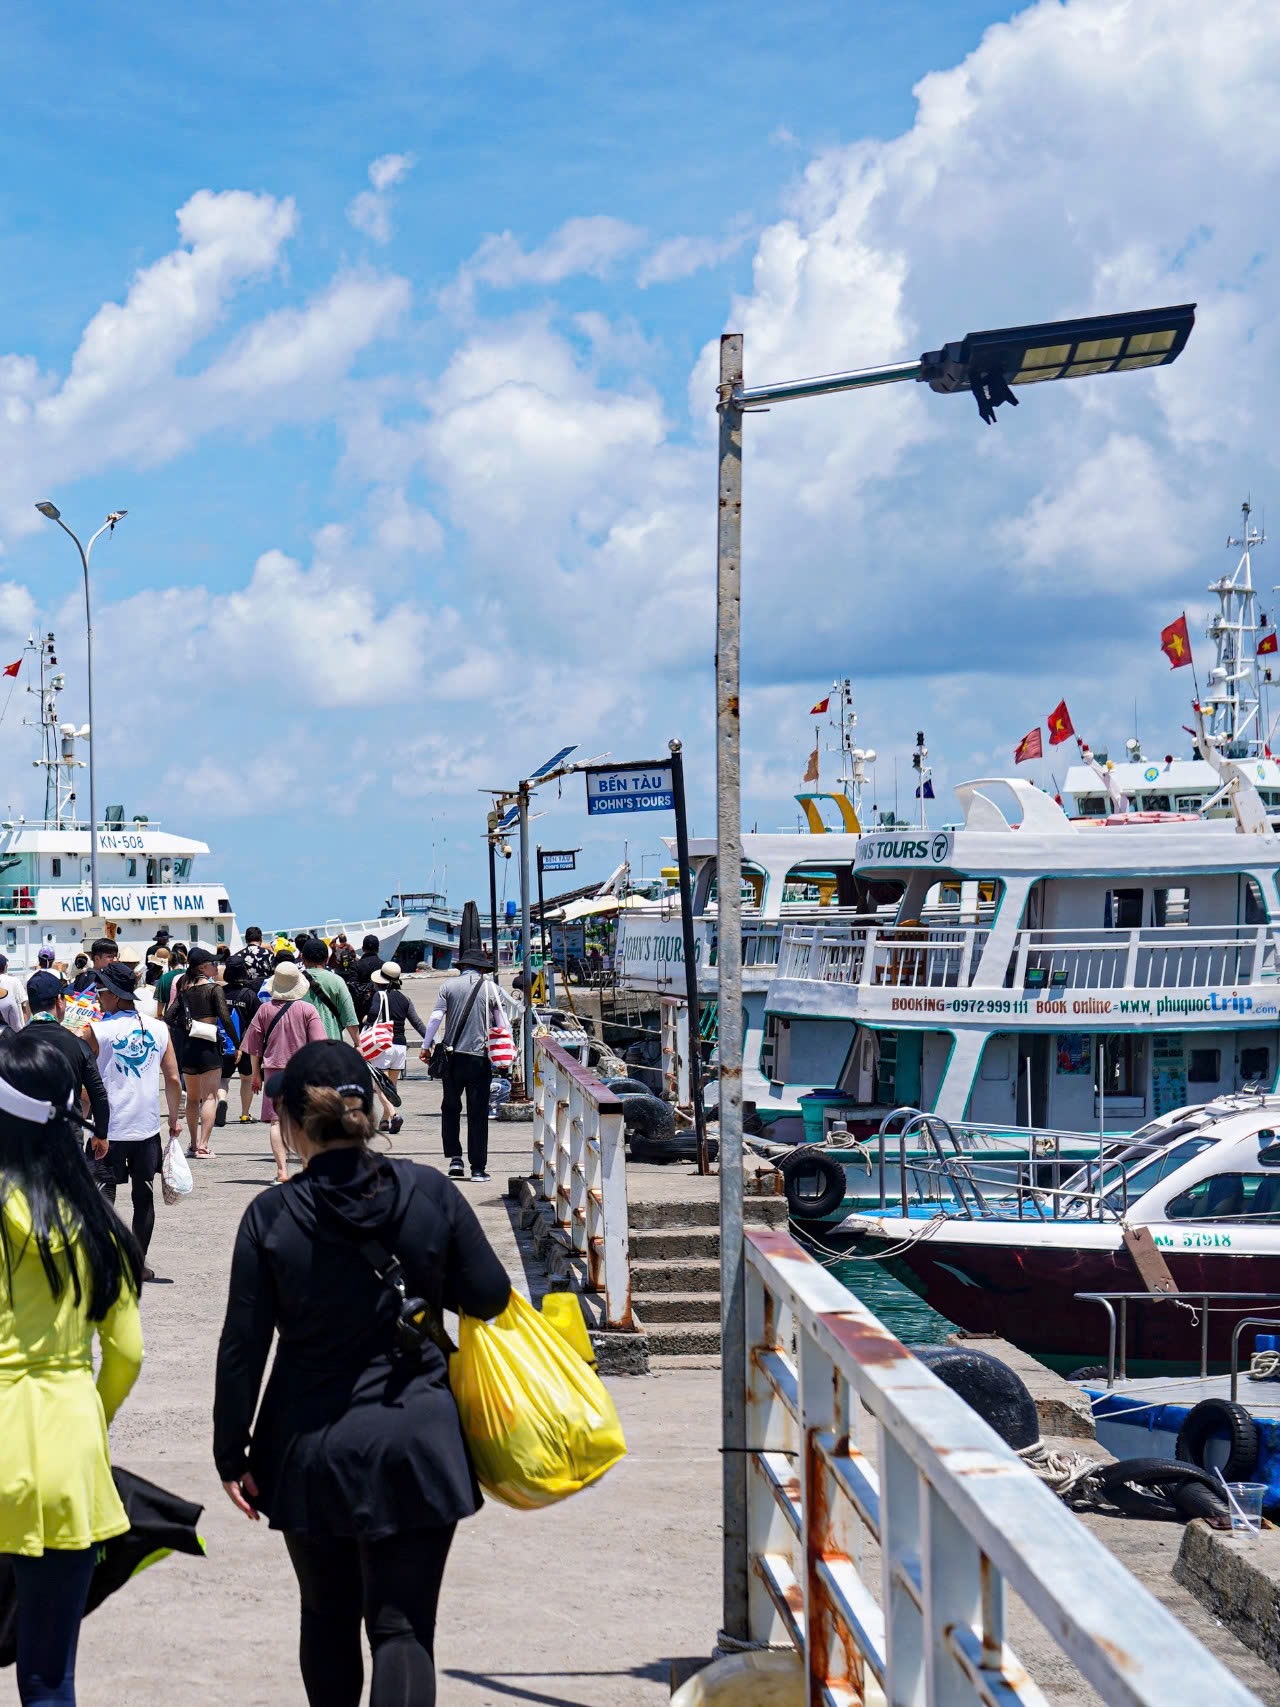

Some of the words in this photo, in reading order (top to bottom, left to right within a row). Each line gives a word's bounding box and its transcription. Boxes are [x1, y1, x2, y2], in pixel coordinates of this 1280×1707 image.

[599, 774, 627, 792] BẾN
[632, 773, 662, 790] TÀU
[592, 798, 633, 811] JOHN'S
[636, 795, 671, 808] TOURS
[100, 835, 144, 849] KN-508
[877, 840, 930, 859] TOURS
[101, 893, 132, 912] NGƯ
[137, 892, 167, 915] VIỆT
[174, 895, 205, 910] NAM
[624, 936, 651, 961] JOHN'S
[653, 935, 685, 963] TOUR
[1036, 1000, 1067, 1014] BOOK
[1183, 1232, 1232, 1247] 57918
